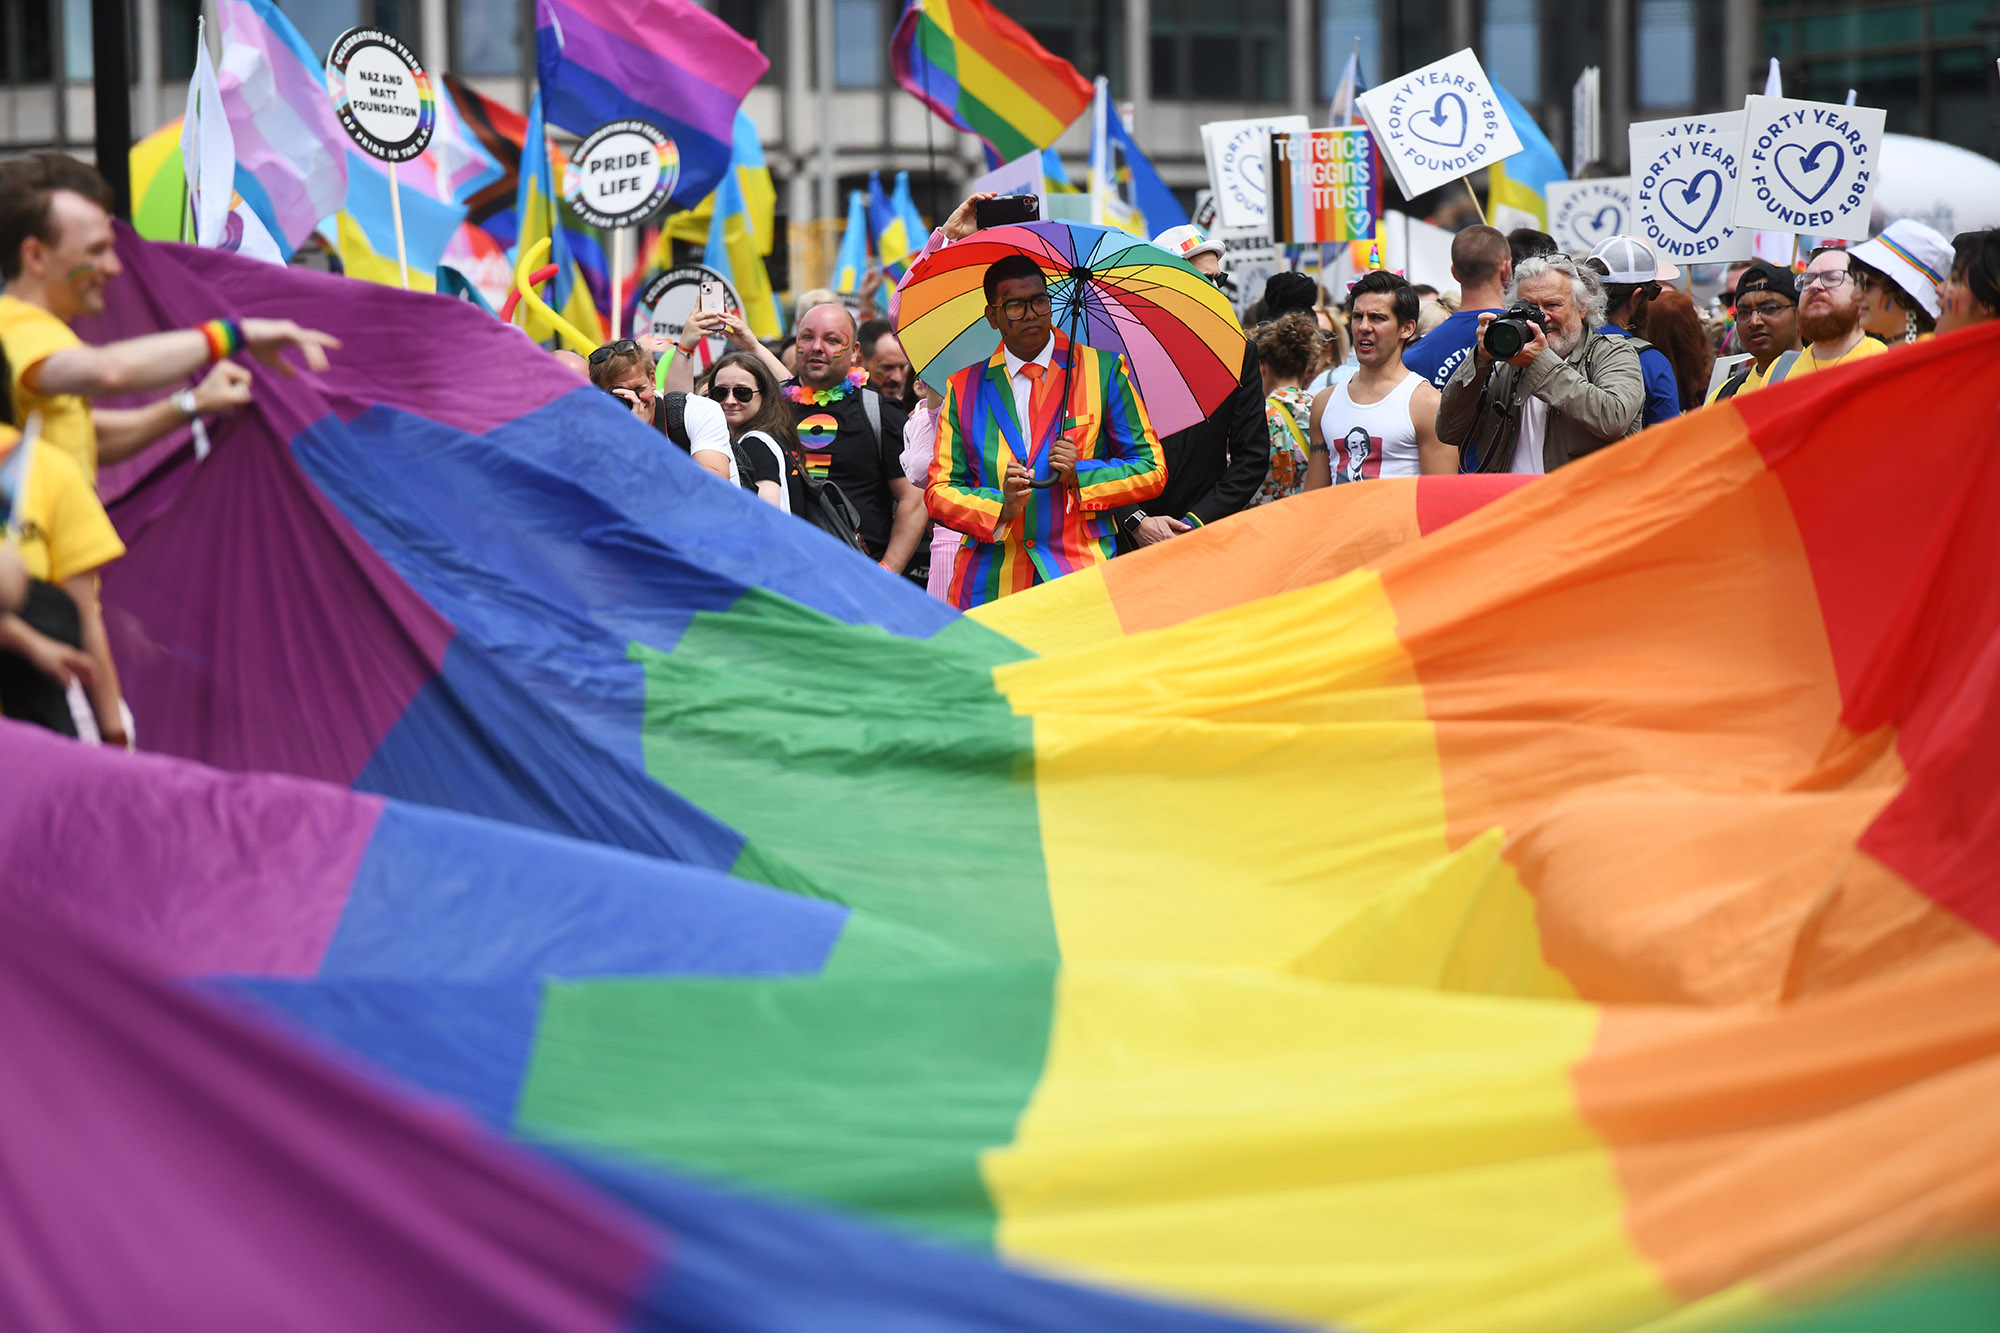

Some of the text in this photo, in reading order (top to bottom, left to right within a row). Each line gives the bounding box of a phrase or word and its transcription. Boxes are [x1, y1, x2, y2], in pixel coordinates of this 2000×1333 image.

[359, 71, 403, 86] NAZ AND
[369, 87, 397, 100] MATT
[353, 100, 418, 118] FOUNDATION
[1388, 72, 1477, 140] FORTY YEARS
[1481, 99, 1499, 140] 1982
[343, 115, 356, 131] OF
[355, 130, 386, 157] PRIDE
[388, 148, 399, 160] IN
[400, 143, 419, 158] THE
[1224, 129, 1251, 173] FORTY
[1752, 109, 1868, 161] FORTY YEARS
[590, 151, 650, 175] PRIDE
[1404, 143, 1486, 172] FOUNDED
[1639, 144, 1682, 201] FORTY
[600, 177, 641, 197] LIFE
[1752, 170, 1870, 227] FOUNDED 1982
[1641, 214, 1720, 257] FOUNDED
[1434, 346, 1472, 387] FORTY
